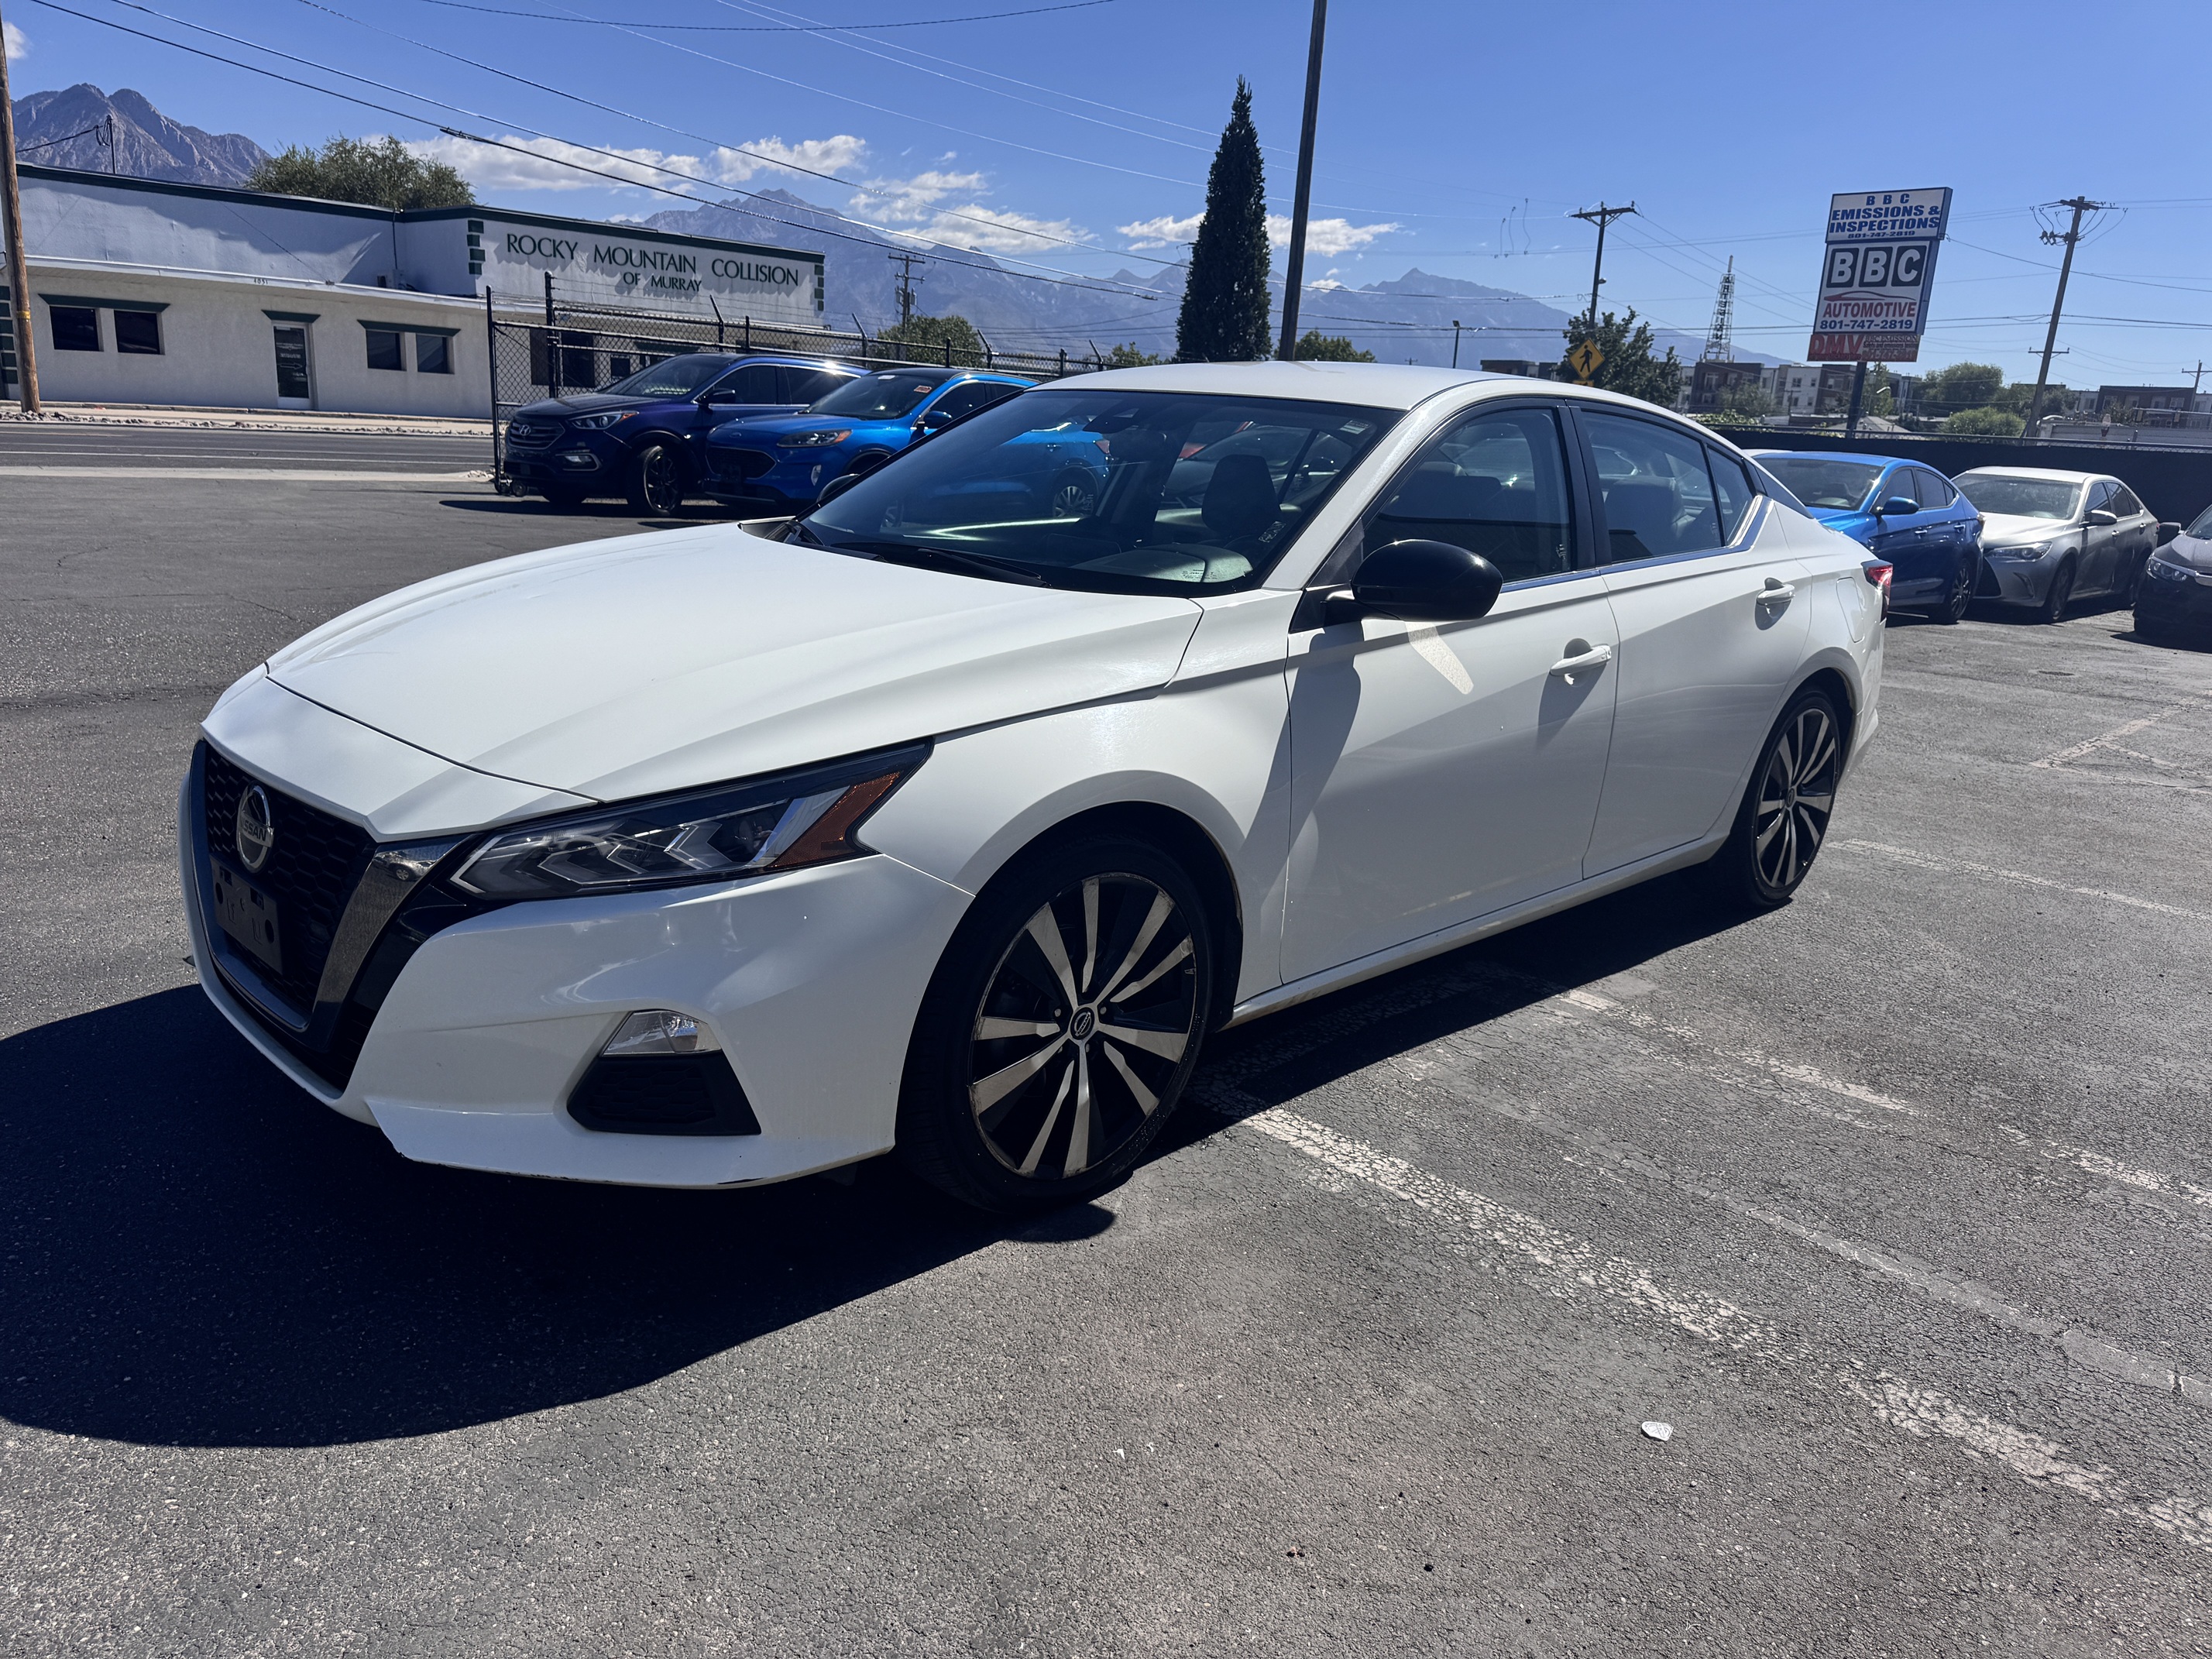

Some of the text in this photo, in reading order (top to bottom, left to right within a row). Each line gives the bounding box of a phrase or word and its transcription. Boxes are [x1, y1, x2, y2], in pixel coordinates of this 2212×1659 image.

[1832, 204, 1940, 221] EMISSIONS &
[1829, 217, 1940, 233] INSPECTIONS
[1848, 230, 1915, 239] 801-747-2819
[507, 233, 799, 287] ROCKY MOUNTAIN COLLISION
[1830, 248, 1921, 283] BBC
[623, 272, 702, 292] OF MURRAY
[1822, 302, 1917, 318] AUTOMOTIVE
[1820, 319, 1913, 329] 801-747-2819
[1808, 334, 1865, 354] DMV
